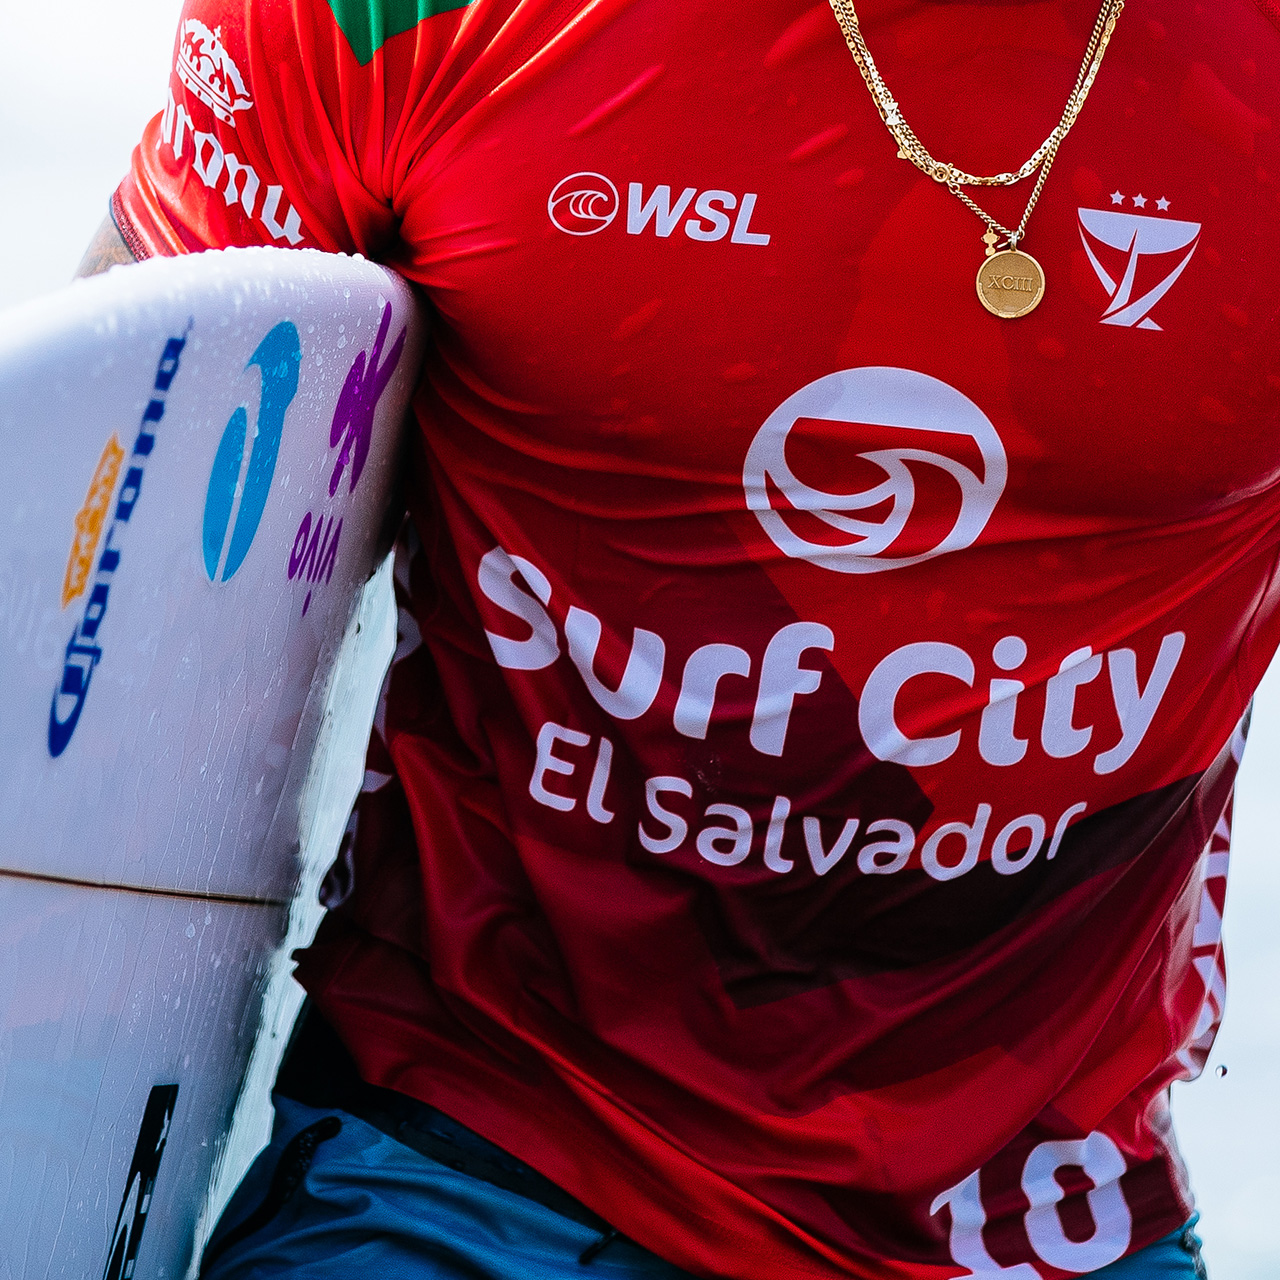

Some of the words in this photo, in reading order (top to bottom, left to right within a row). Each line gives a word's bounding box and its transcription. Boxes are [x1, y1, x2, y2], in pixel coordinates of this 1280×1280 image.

[625, 182, 771, 247] WSL
[987, 274, 1034, 292] XCIII
[477, 545, 835, 757] Surf
[858, 631, 1187, 775] City
[528, 721, 615, 825] El
[637, 775, 1088, 882] Salvador
[929, 1130, 1133, 1280] 10
